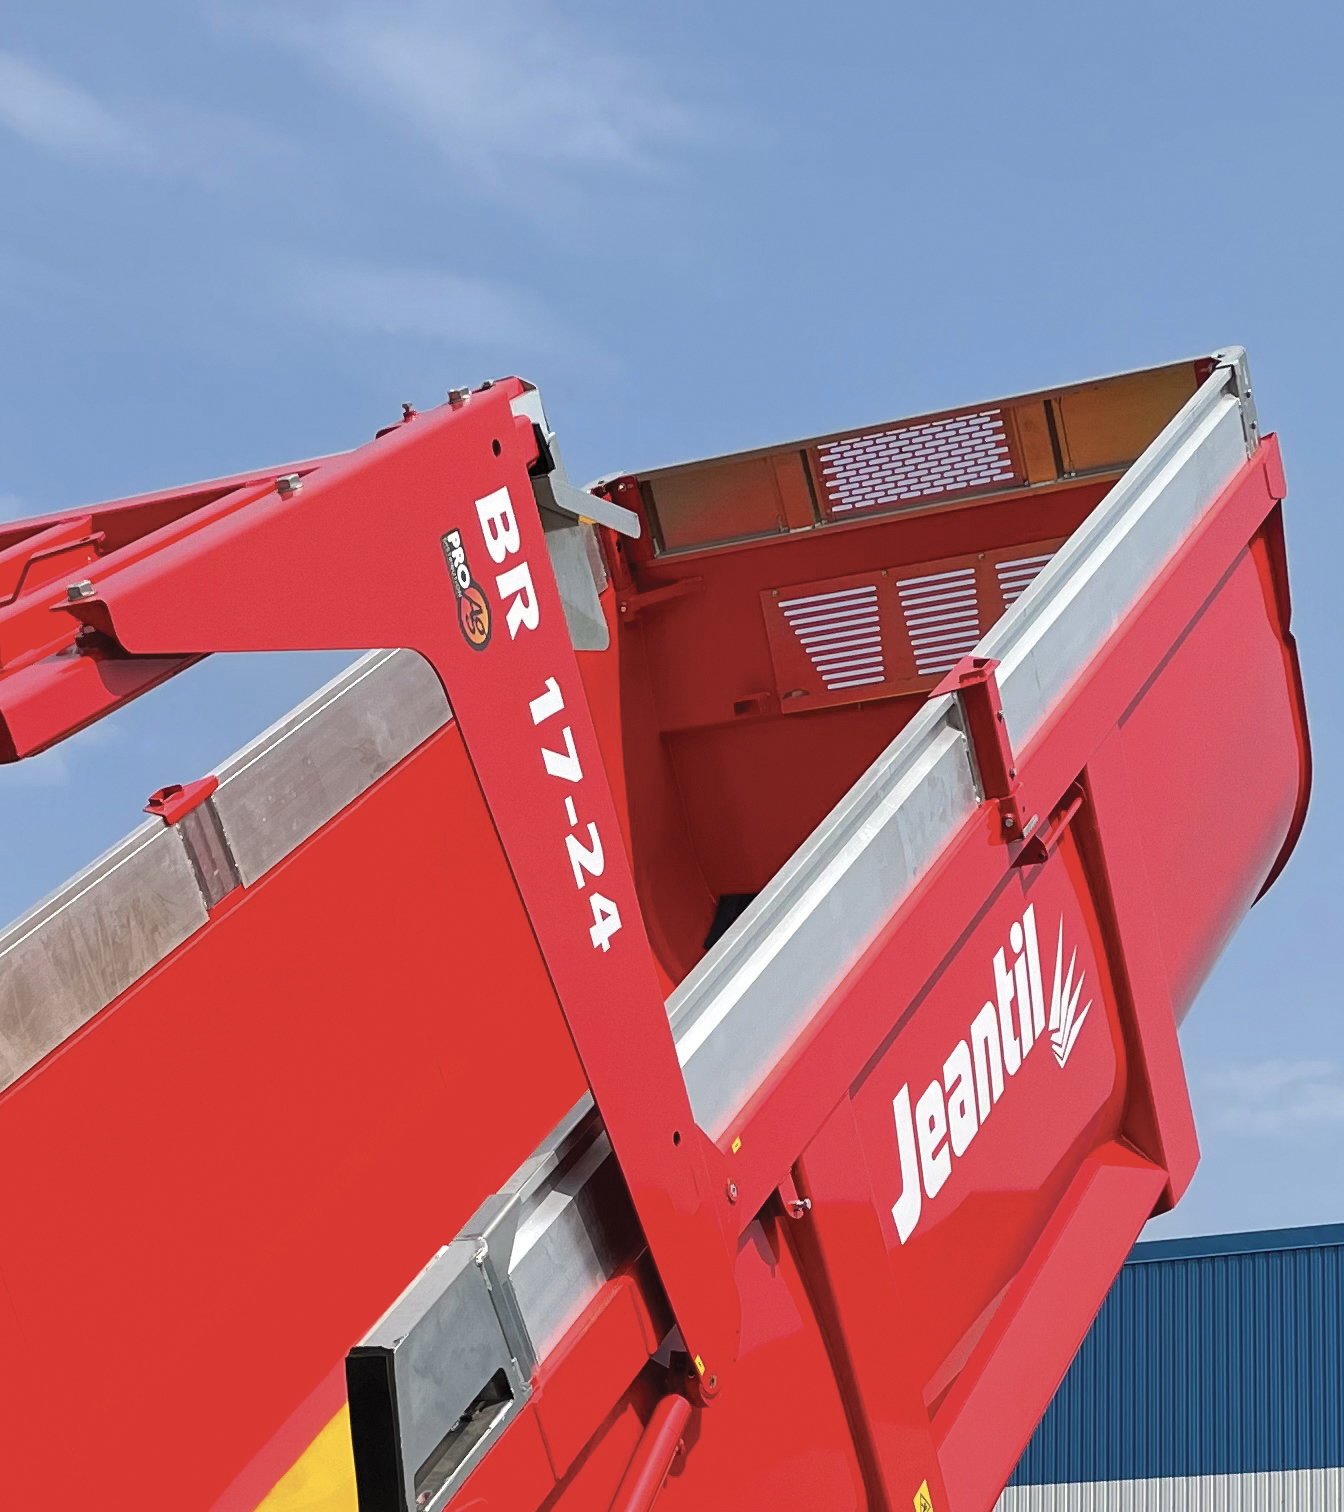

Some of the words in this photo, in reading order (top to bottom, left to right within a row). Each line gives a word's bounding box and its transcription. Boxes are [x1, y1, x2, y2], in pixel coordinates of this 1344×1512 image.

[447, 530, 471, 589] PRO
[475, 485, 540, 640] BR
[529, 676, 622, 953] 17-24
[891, 903, 1046, 1245] Jeantil
